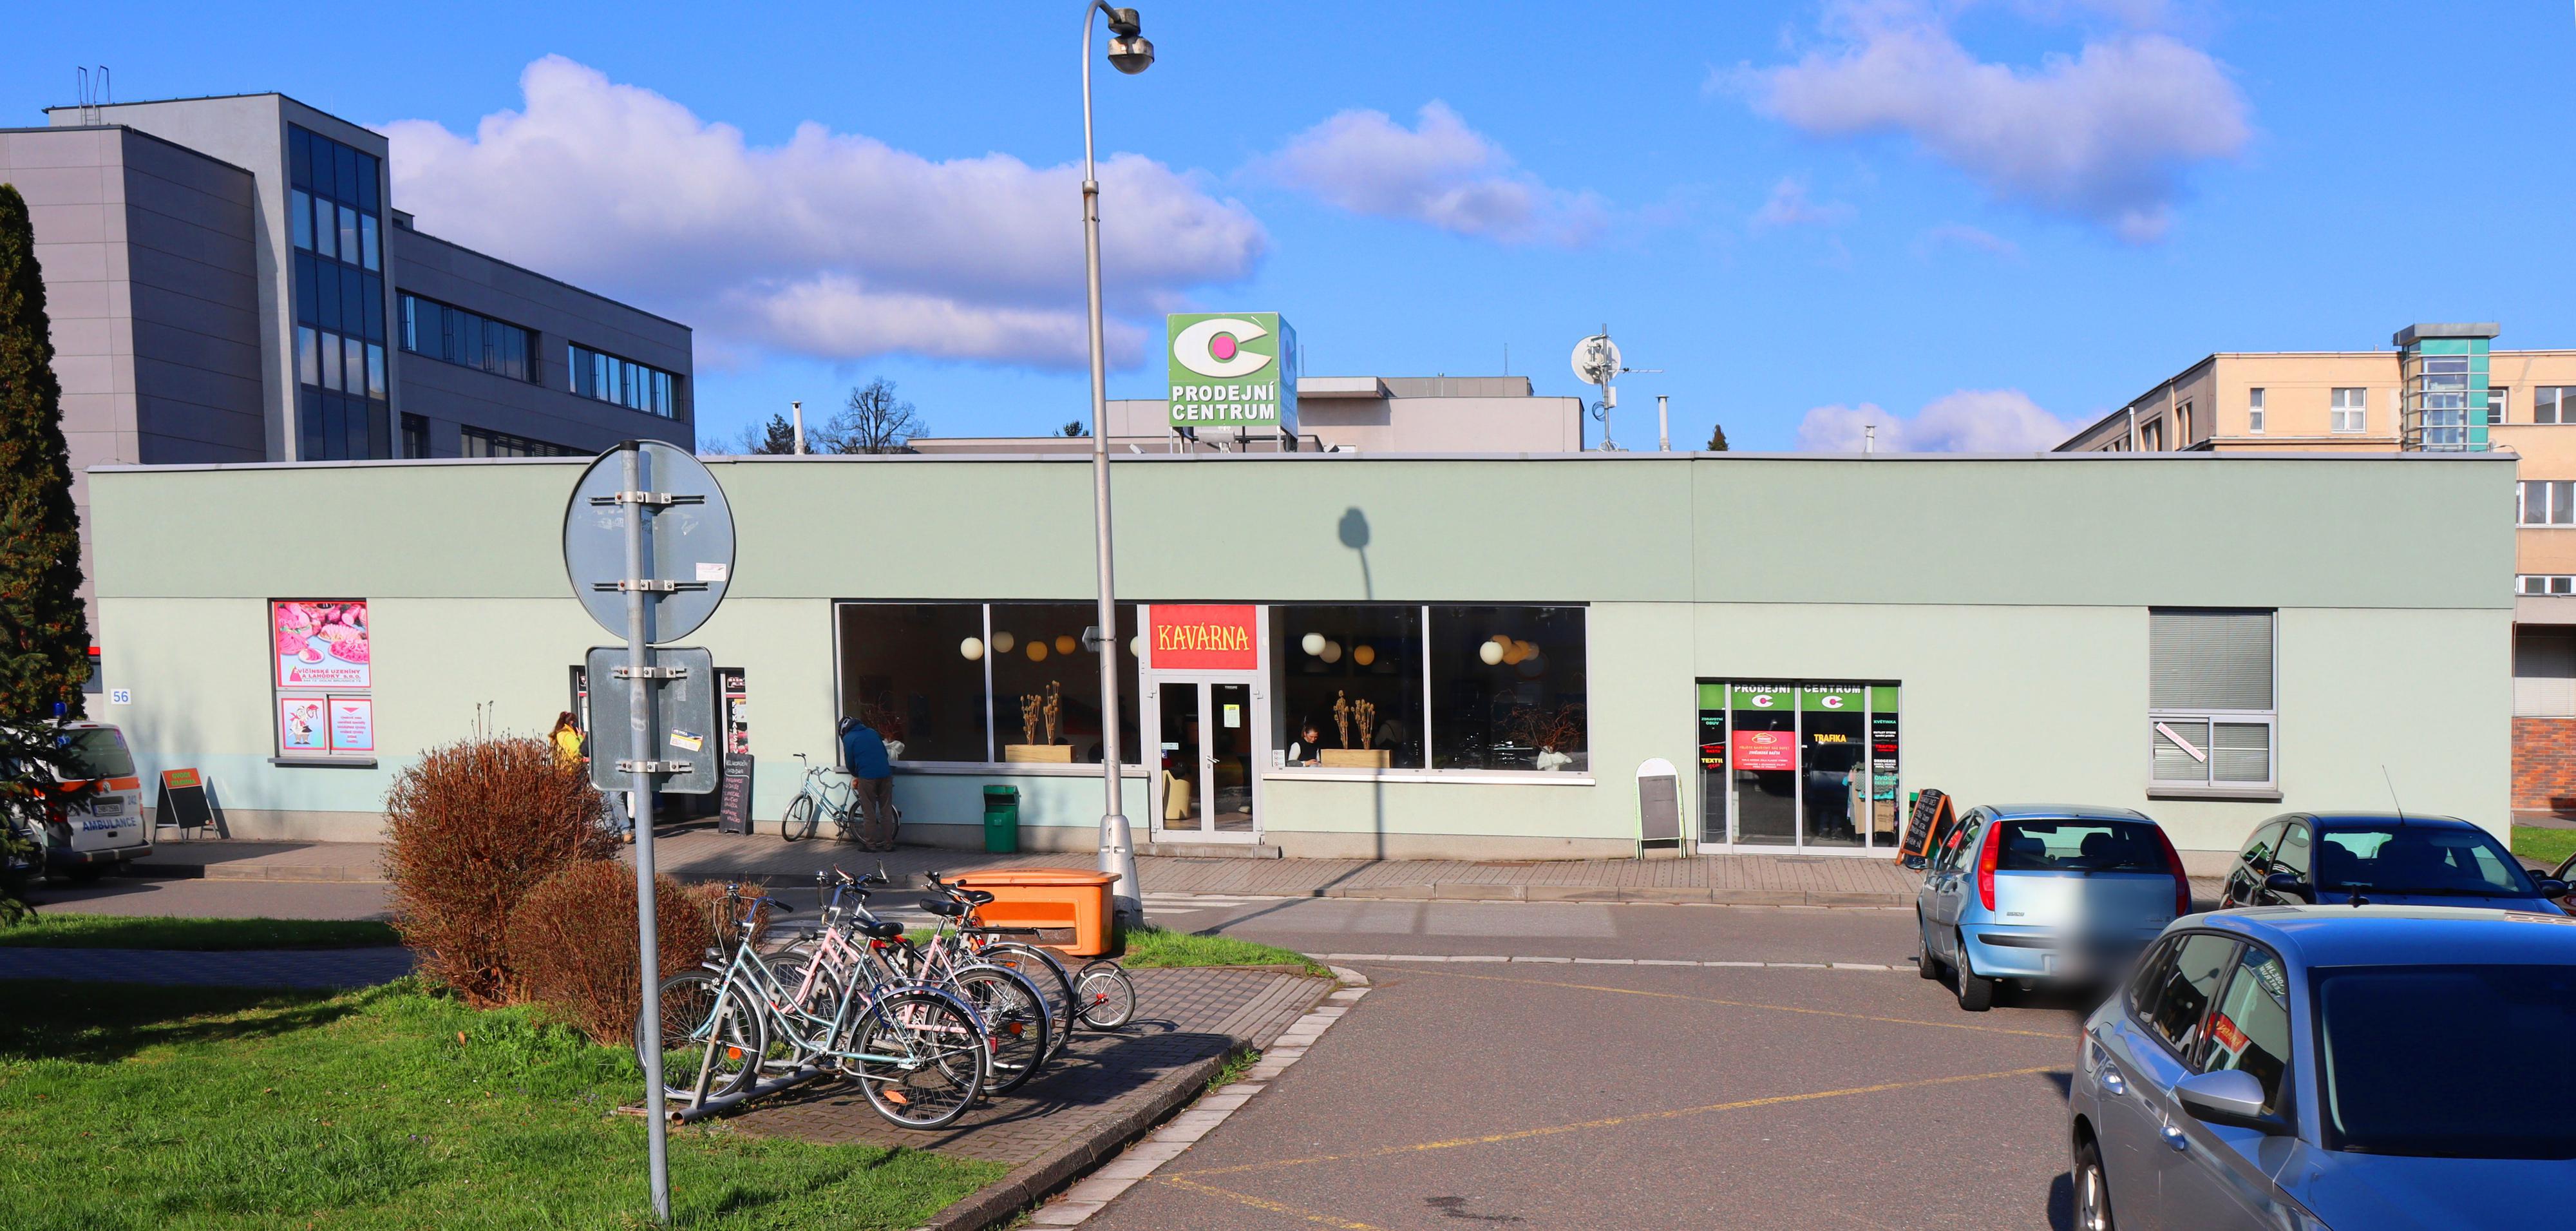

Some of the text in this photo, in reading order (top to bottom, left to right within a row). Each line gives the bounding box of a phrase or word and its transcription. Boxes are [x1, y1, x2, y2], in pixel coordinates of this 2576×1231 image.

[1172, 381, 1274, 402] PRODEJNÍ
[1172, 403, 1274, 421] CENTRUM
[1157, 622, 1250, 651] KAVÁRNA
[113, 691, 129, 702] 56
[1734, 683, 1861, 694] PRODEJNÍ CENTRUM
[83, 817, 137, 831] AMBULANCE
